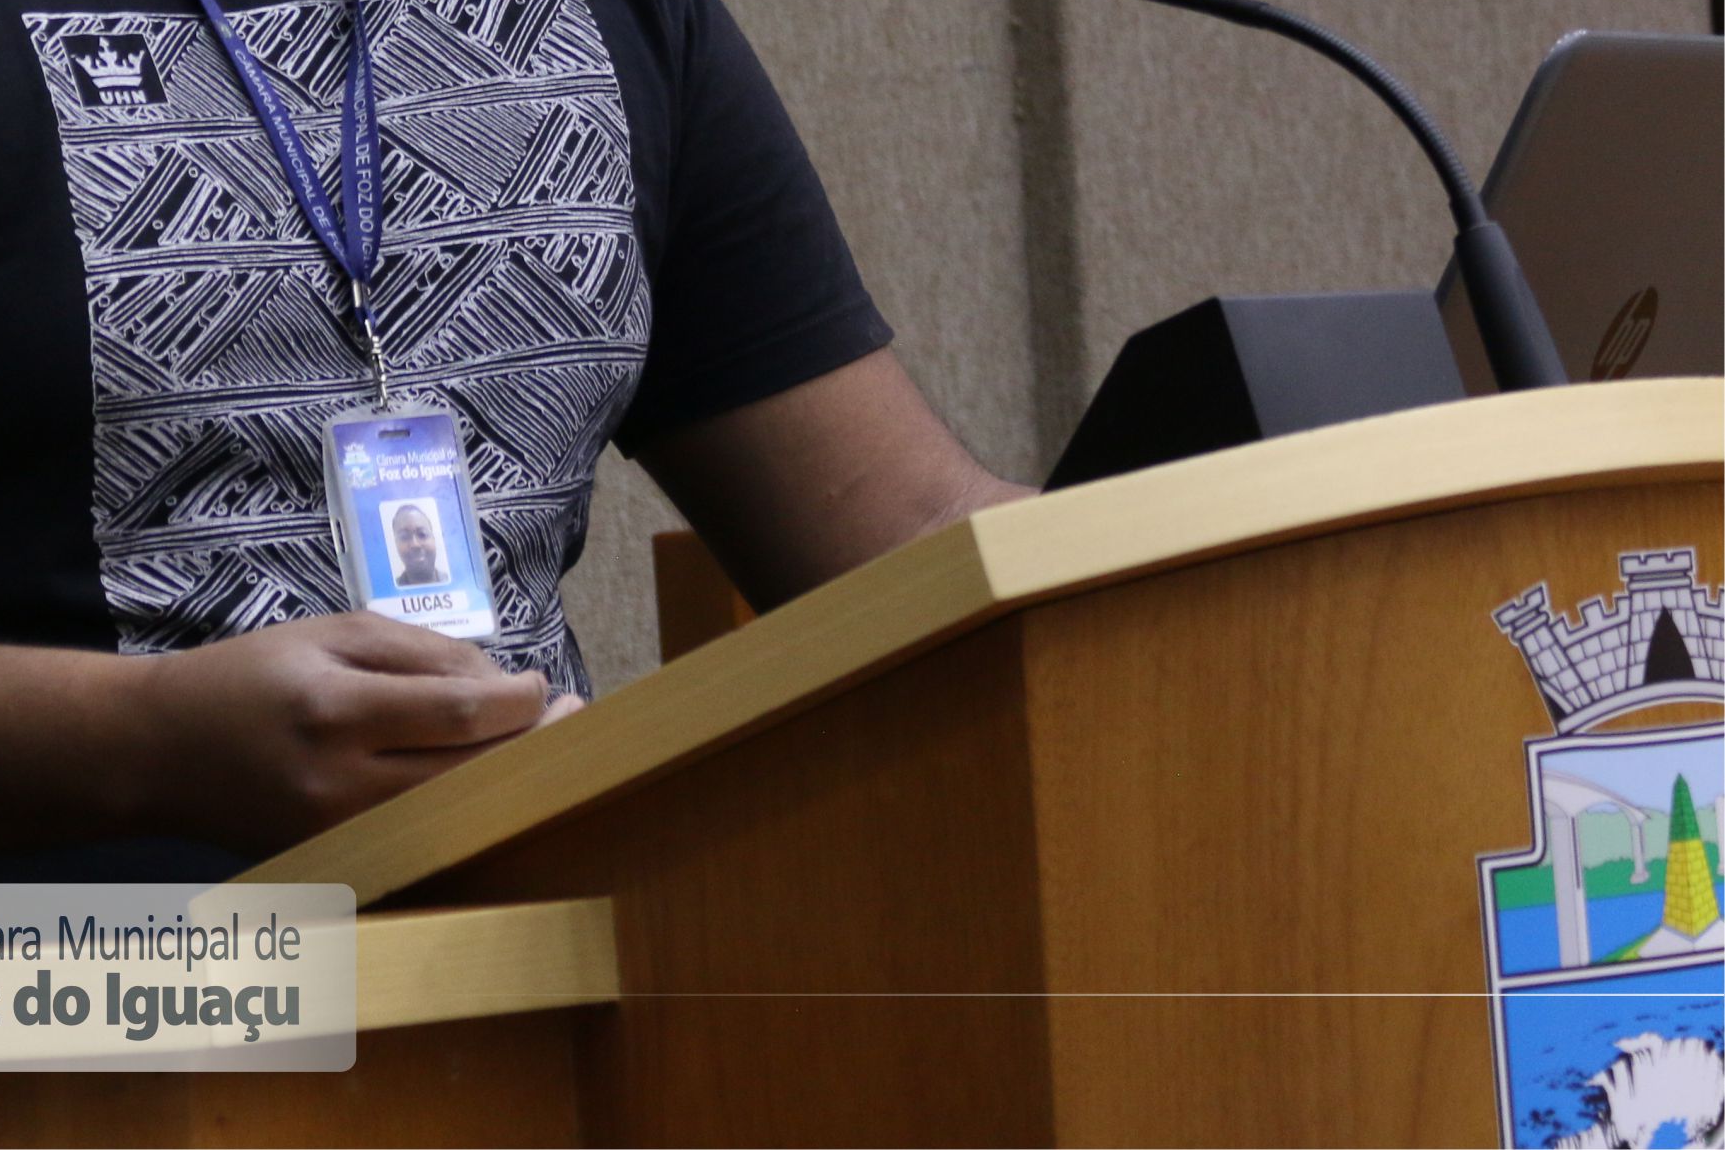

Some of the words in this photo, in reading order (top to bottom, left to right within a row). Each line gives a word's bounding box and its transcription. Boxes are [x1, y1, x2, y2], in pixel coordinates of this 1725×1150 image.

[98, 90, 147, 105] UHN
[235, 50, 275, 114] CÂMARA
[273, 116, 317, 201] MUNICIPAL
[312, 206, 332, 228] DE
[356, 144, 370, 167] DE
[356, 169, 373, 204] FOZ
[359, 207, 373, 233] DO
[1596, 286, 1654, 380] hp
[407, 447, 446, 464] Municipal
[378, 466, 401, 482] Foz
[402, 464, 419, 480] do
[401, 593, 453, 614] LUCAS
